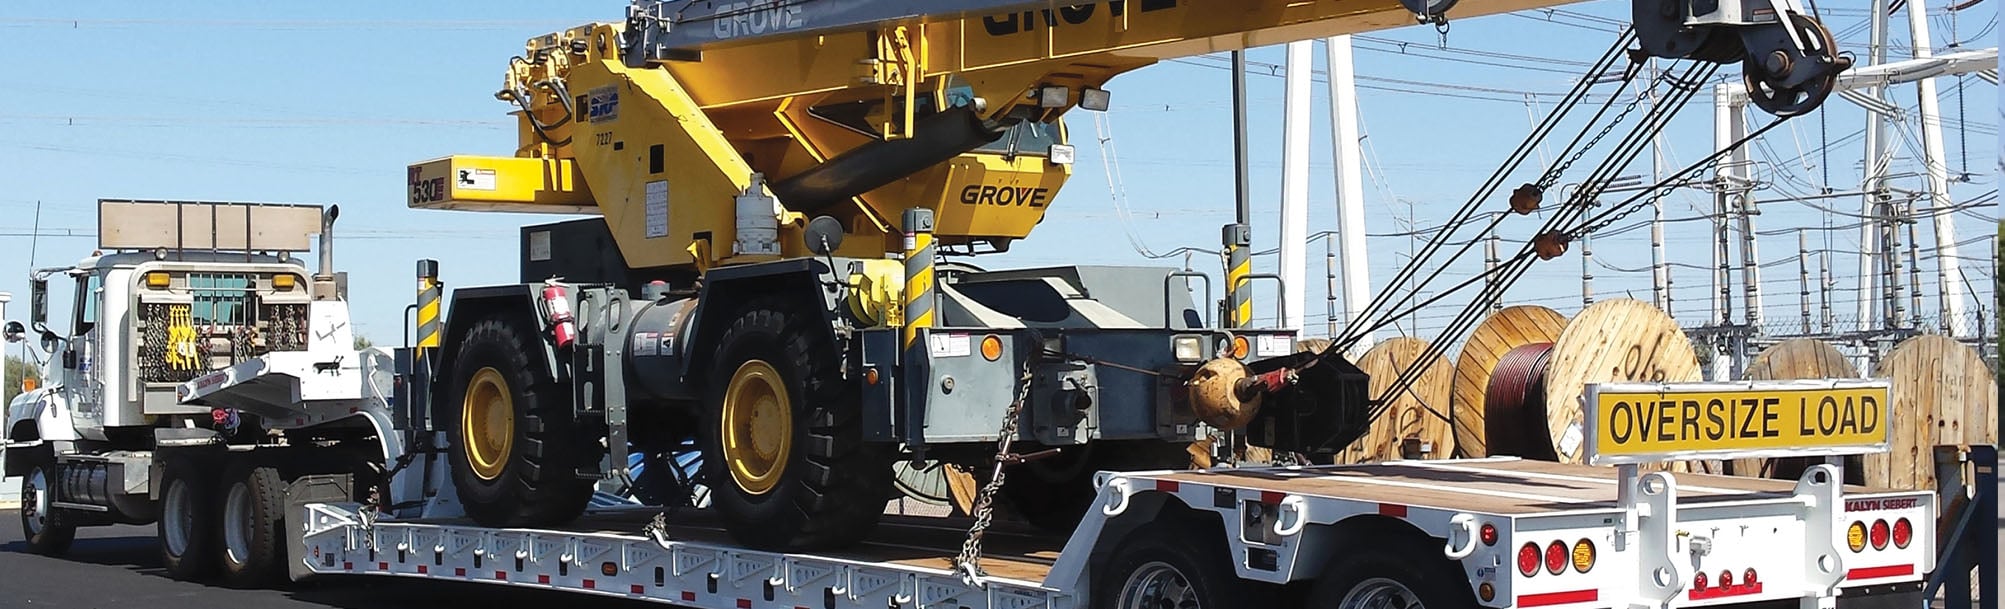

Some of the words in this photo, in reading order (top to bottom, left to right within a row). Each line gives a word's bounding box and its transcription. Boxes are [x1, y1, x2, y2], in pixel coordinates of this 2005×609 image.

[714, 0, 802, 39] GROVE
[596, 131, 612, 146] 7227
[960, 184, 1048, 207] GROVE
[1609, 398, 1779, 444] OVERSIZE
[1800, 395, 1878, 436] LOAD
[1844, 501, 1881, 512] KALYN
[1882, 498, 1917, 510] SIEBERT
